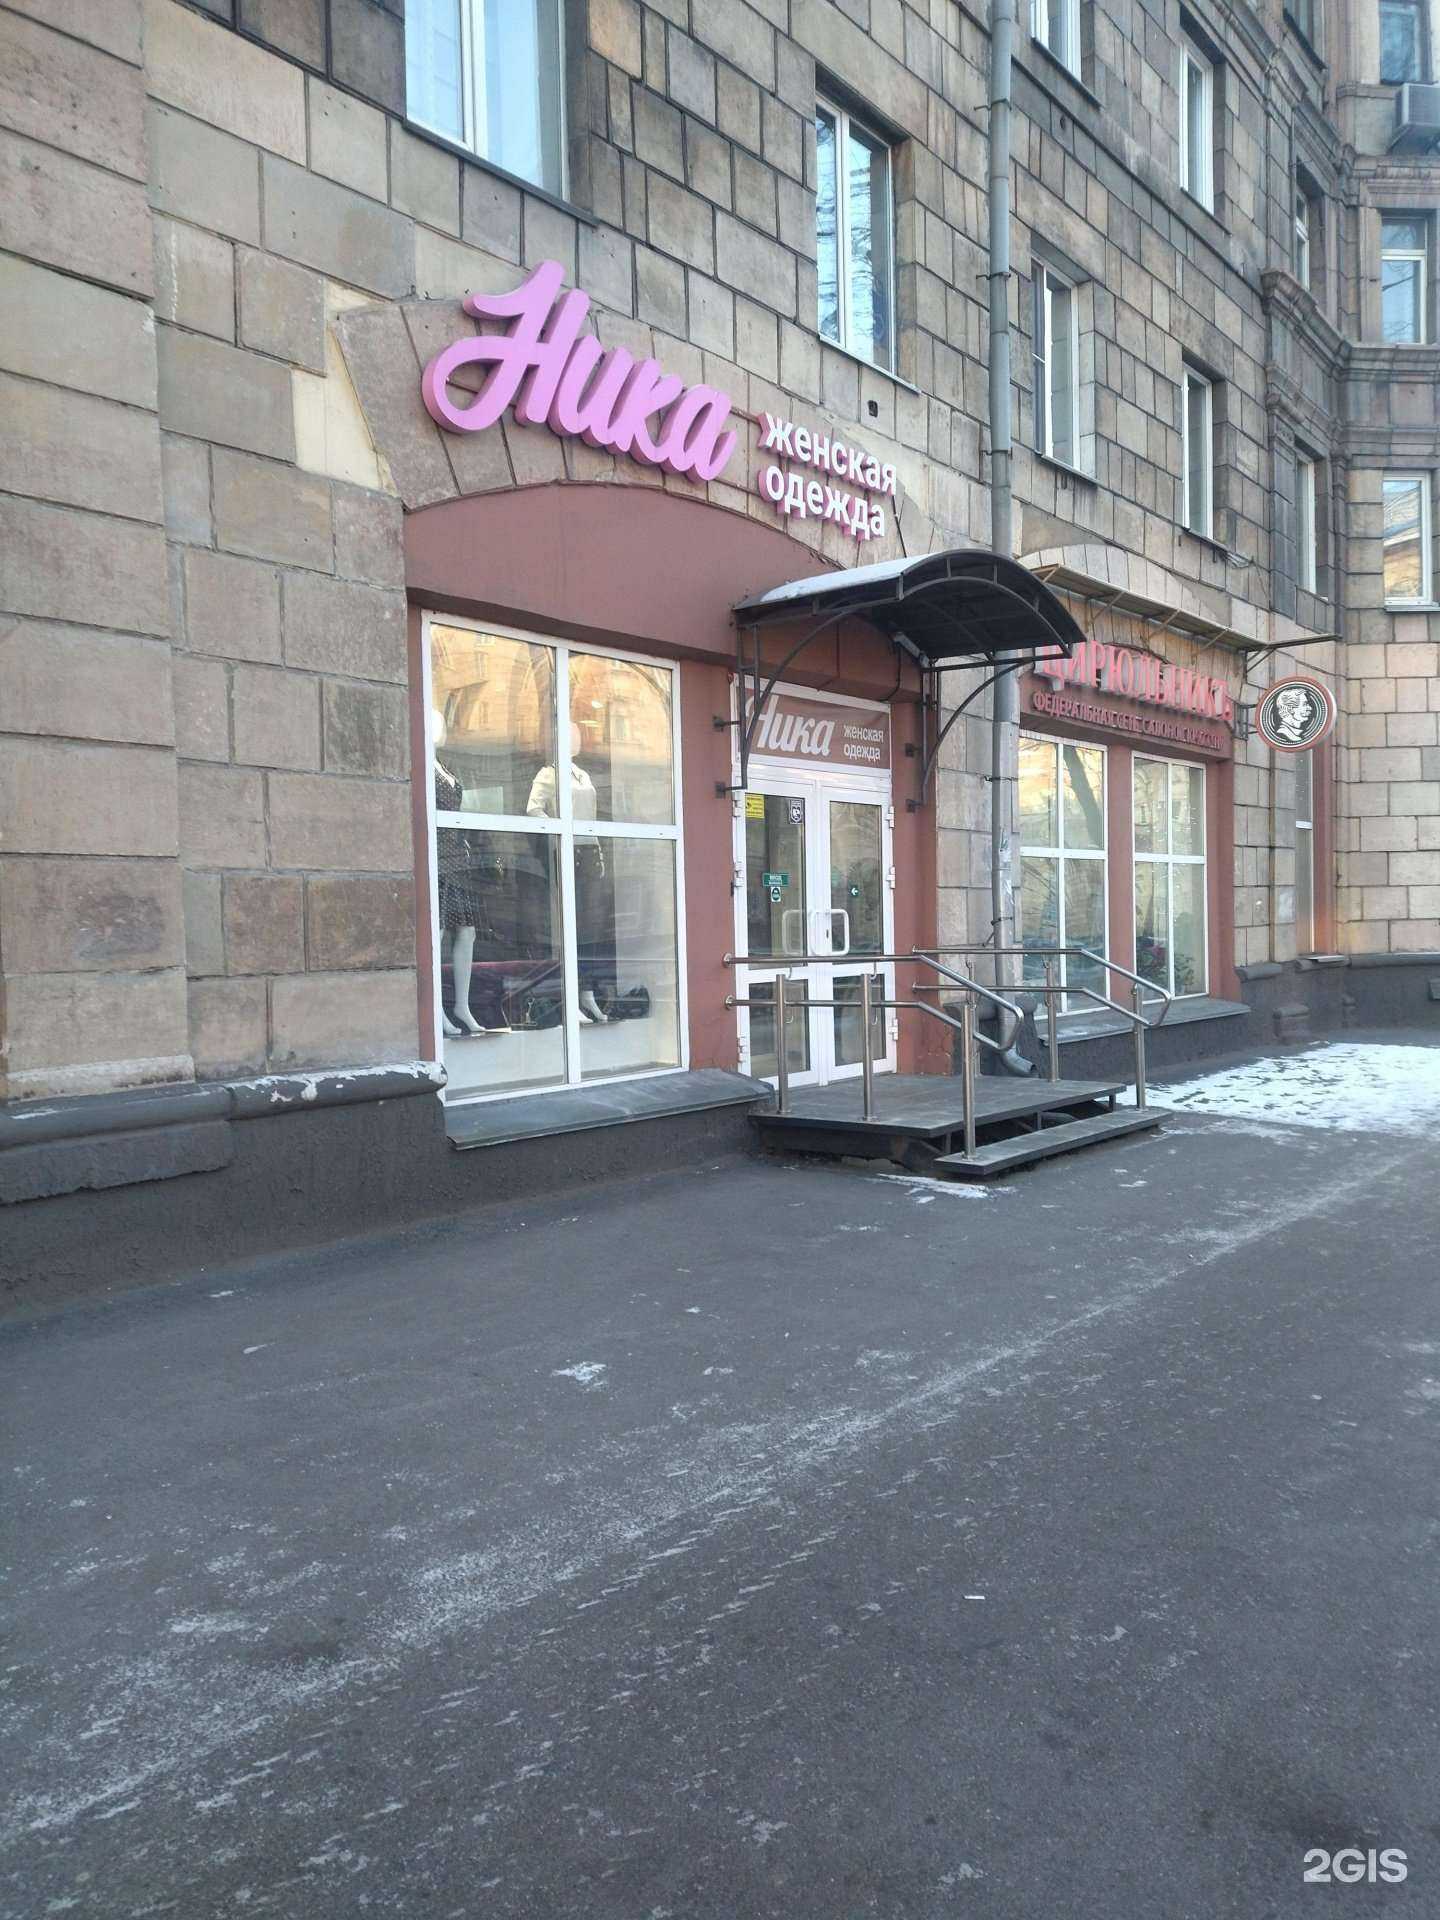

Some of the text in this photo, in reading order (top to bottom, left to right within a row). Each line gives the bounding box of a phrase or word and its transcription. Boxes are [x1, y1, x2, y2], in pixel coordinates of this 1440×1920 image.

[422, 260, 737, 482] Ника
[759, 411, 897, 496] женская
[760, 465, 885, 541] одежда
[843, 724, 884, 743] женская
[843, 743, 881, 762] одежда
